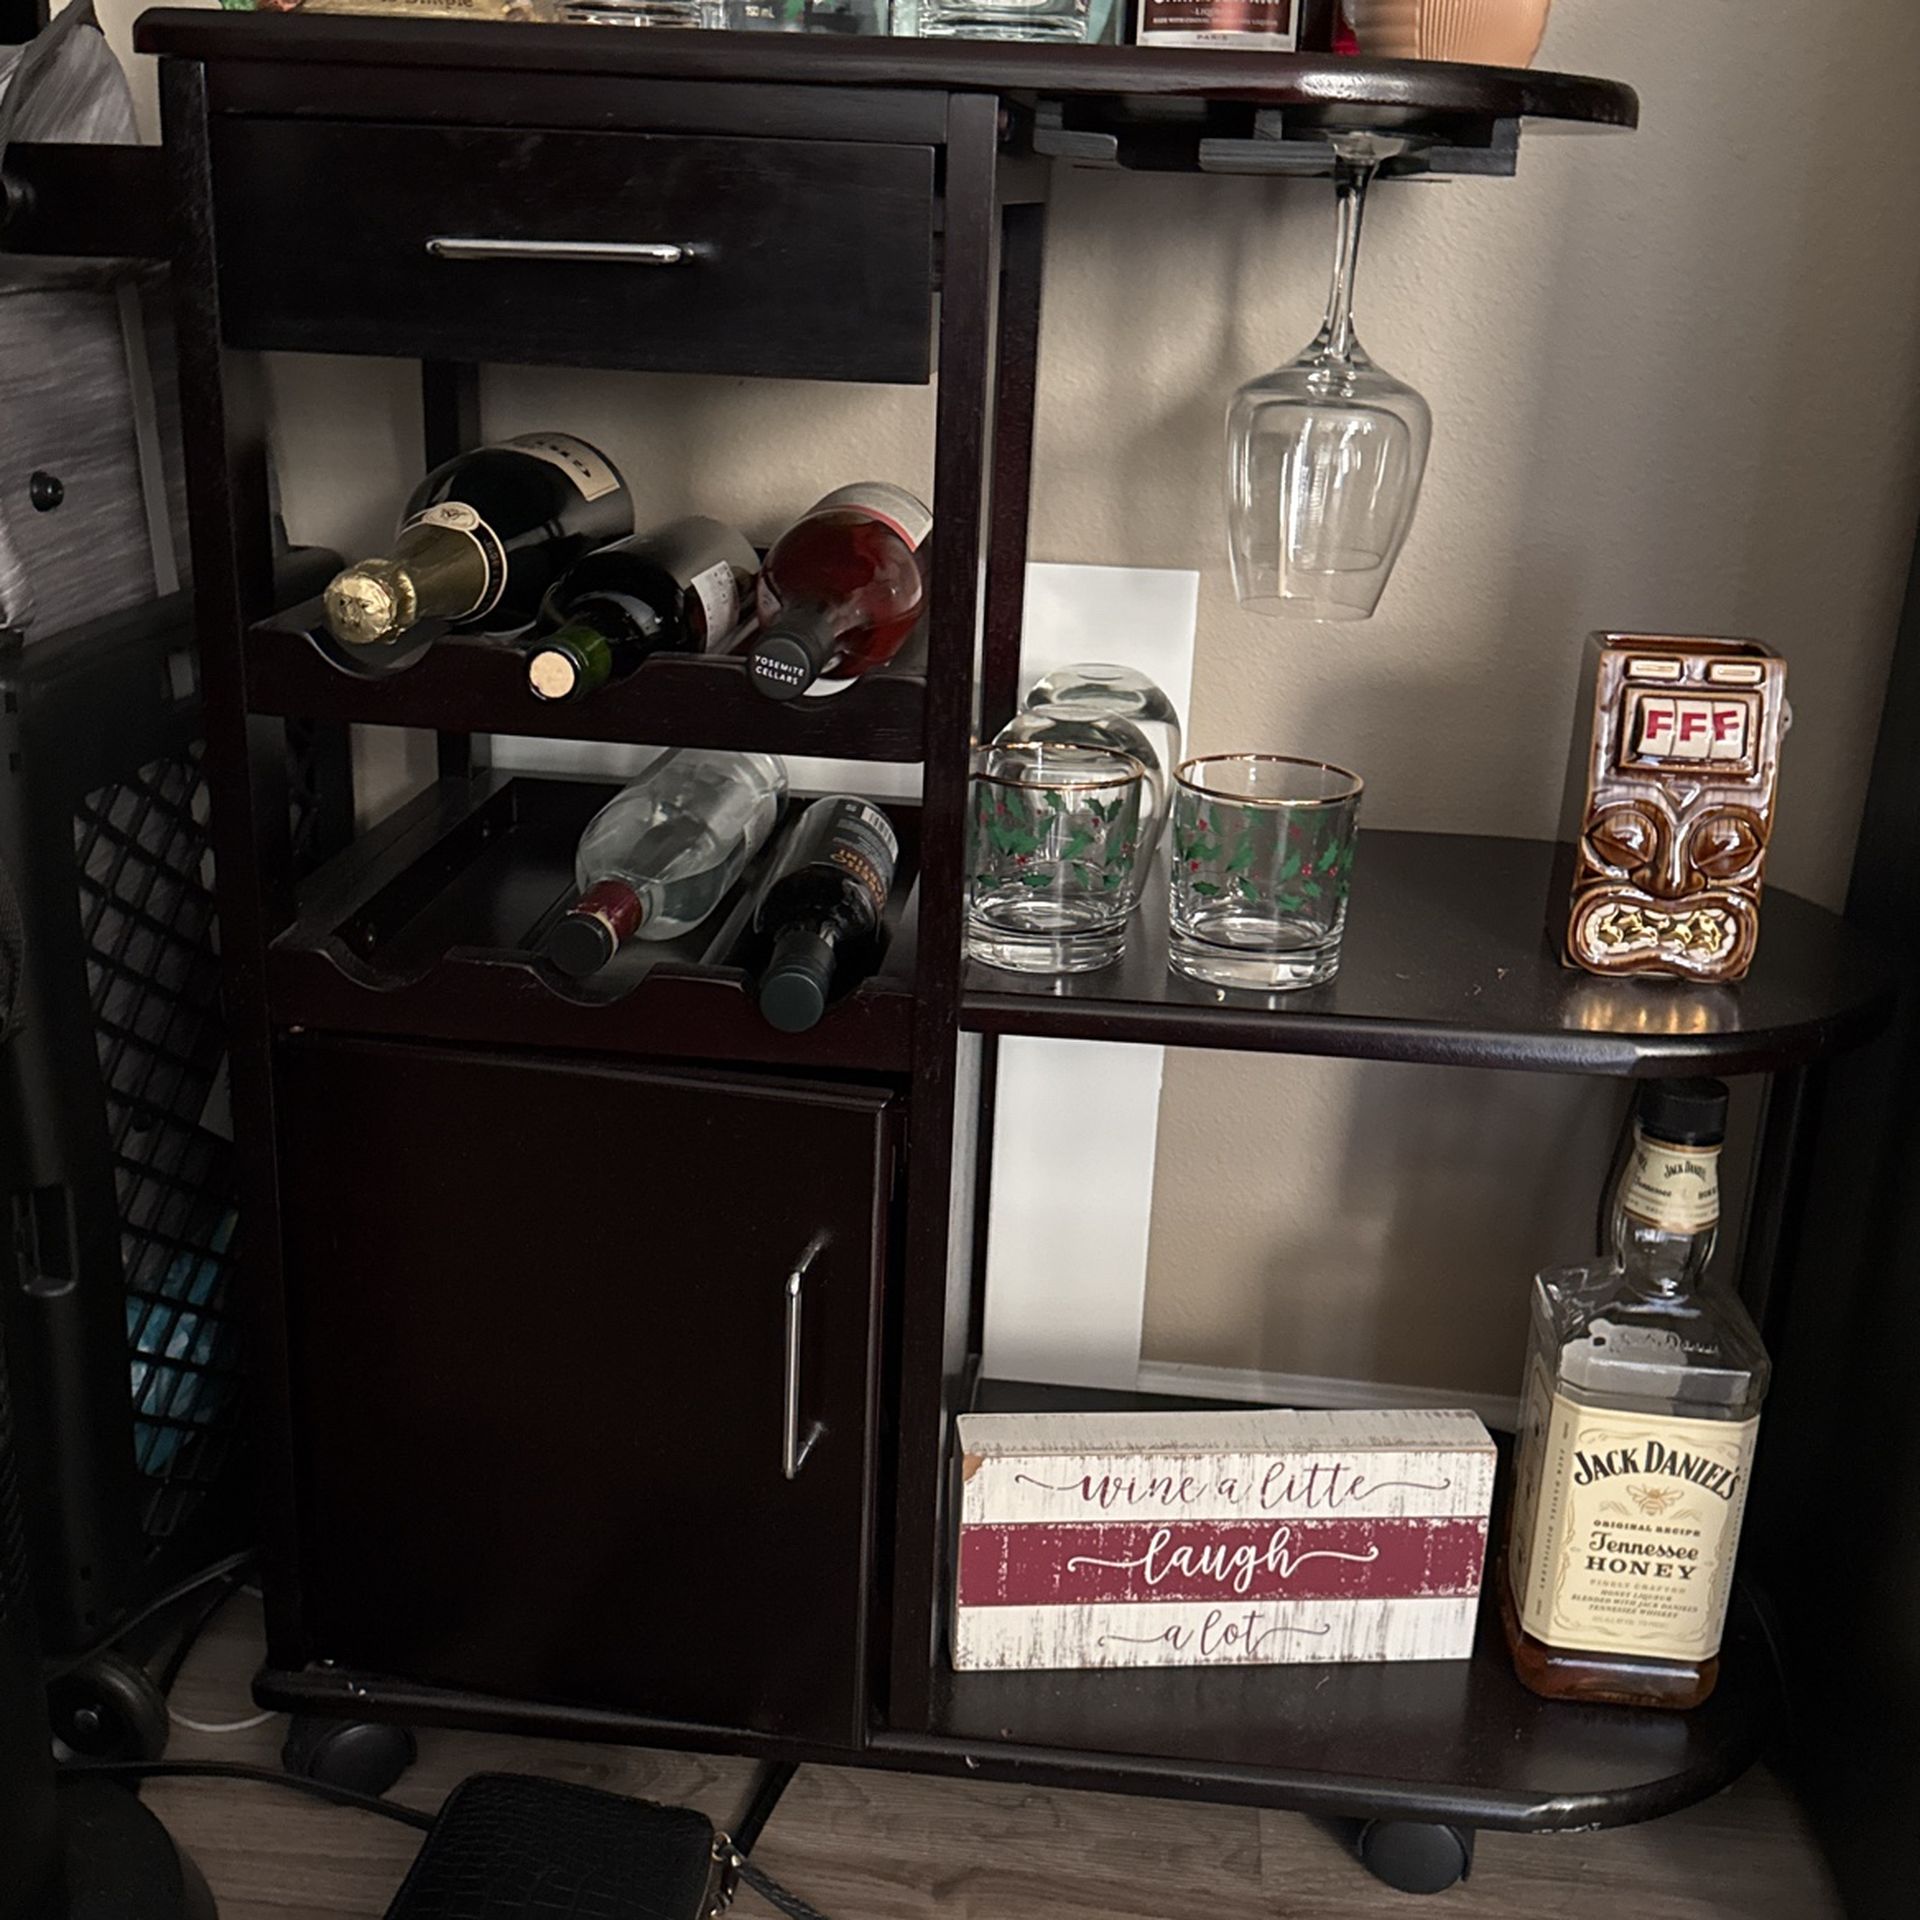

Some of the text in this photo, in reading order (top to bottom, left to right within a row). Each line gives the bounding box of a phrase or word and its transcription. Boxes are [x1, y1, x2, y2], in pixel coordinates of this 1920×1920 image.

[754, 654, 805, 677] YOSEMITE
[755, 665, 798, 686] CELLARS
[1574, 1447, 1641, 1486] JACK
[1643, 1440, 1742, 1500] DANIEL'S
[1218, 1478, 1253, 1504] a
[1593, 1520, 1701, 1537] ORIGINAL RECIPE
[1588, 1531, 1699, 1560] Tennessee
[1584, 1555, 1697, 1580] HONEY
